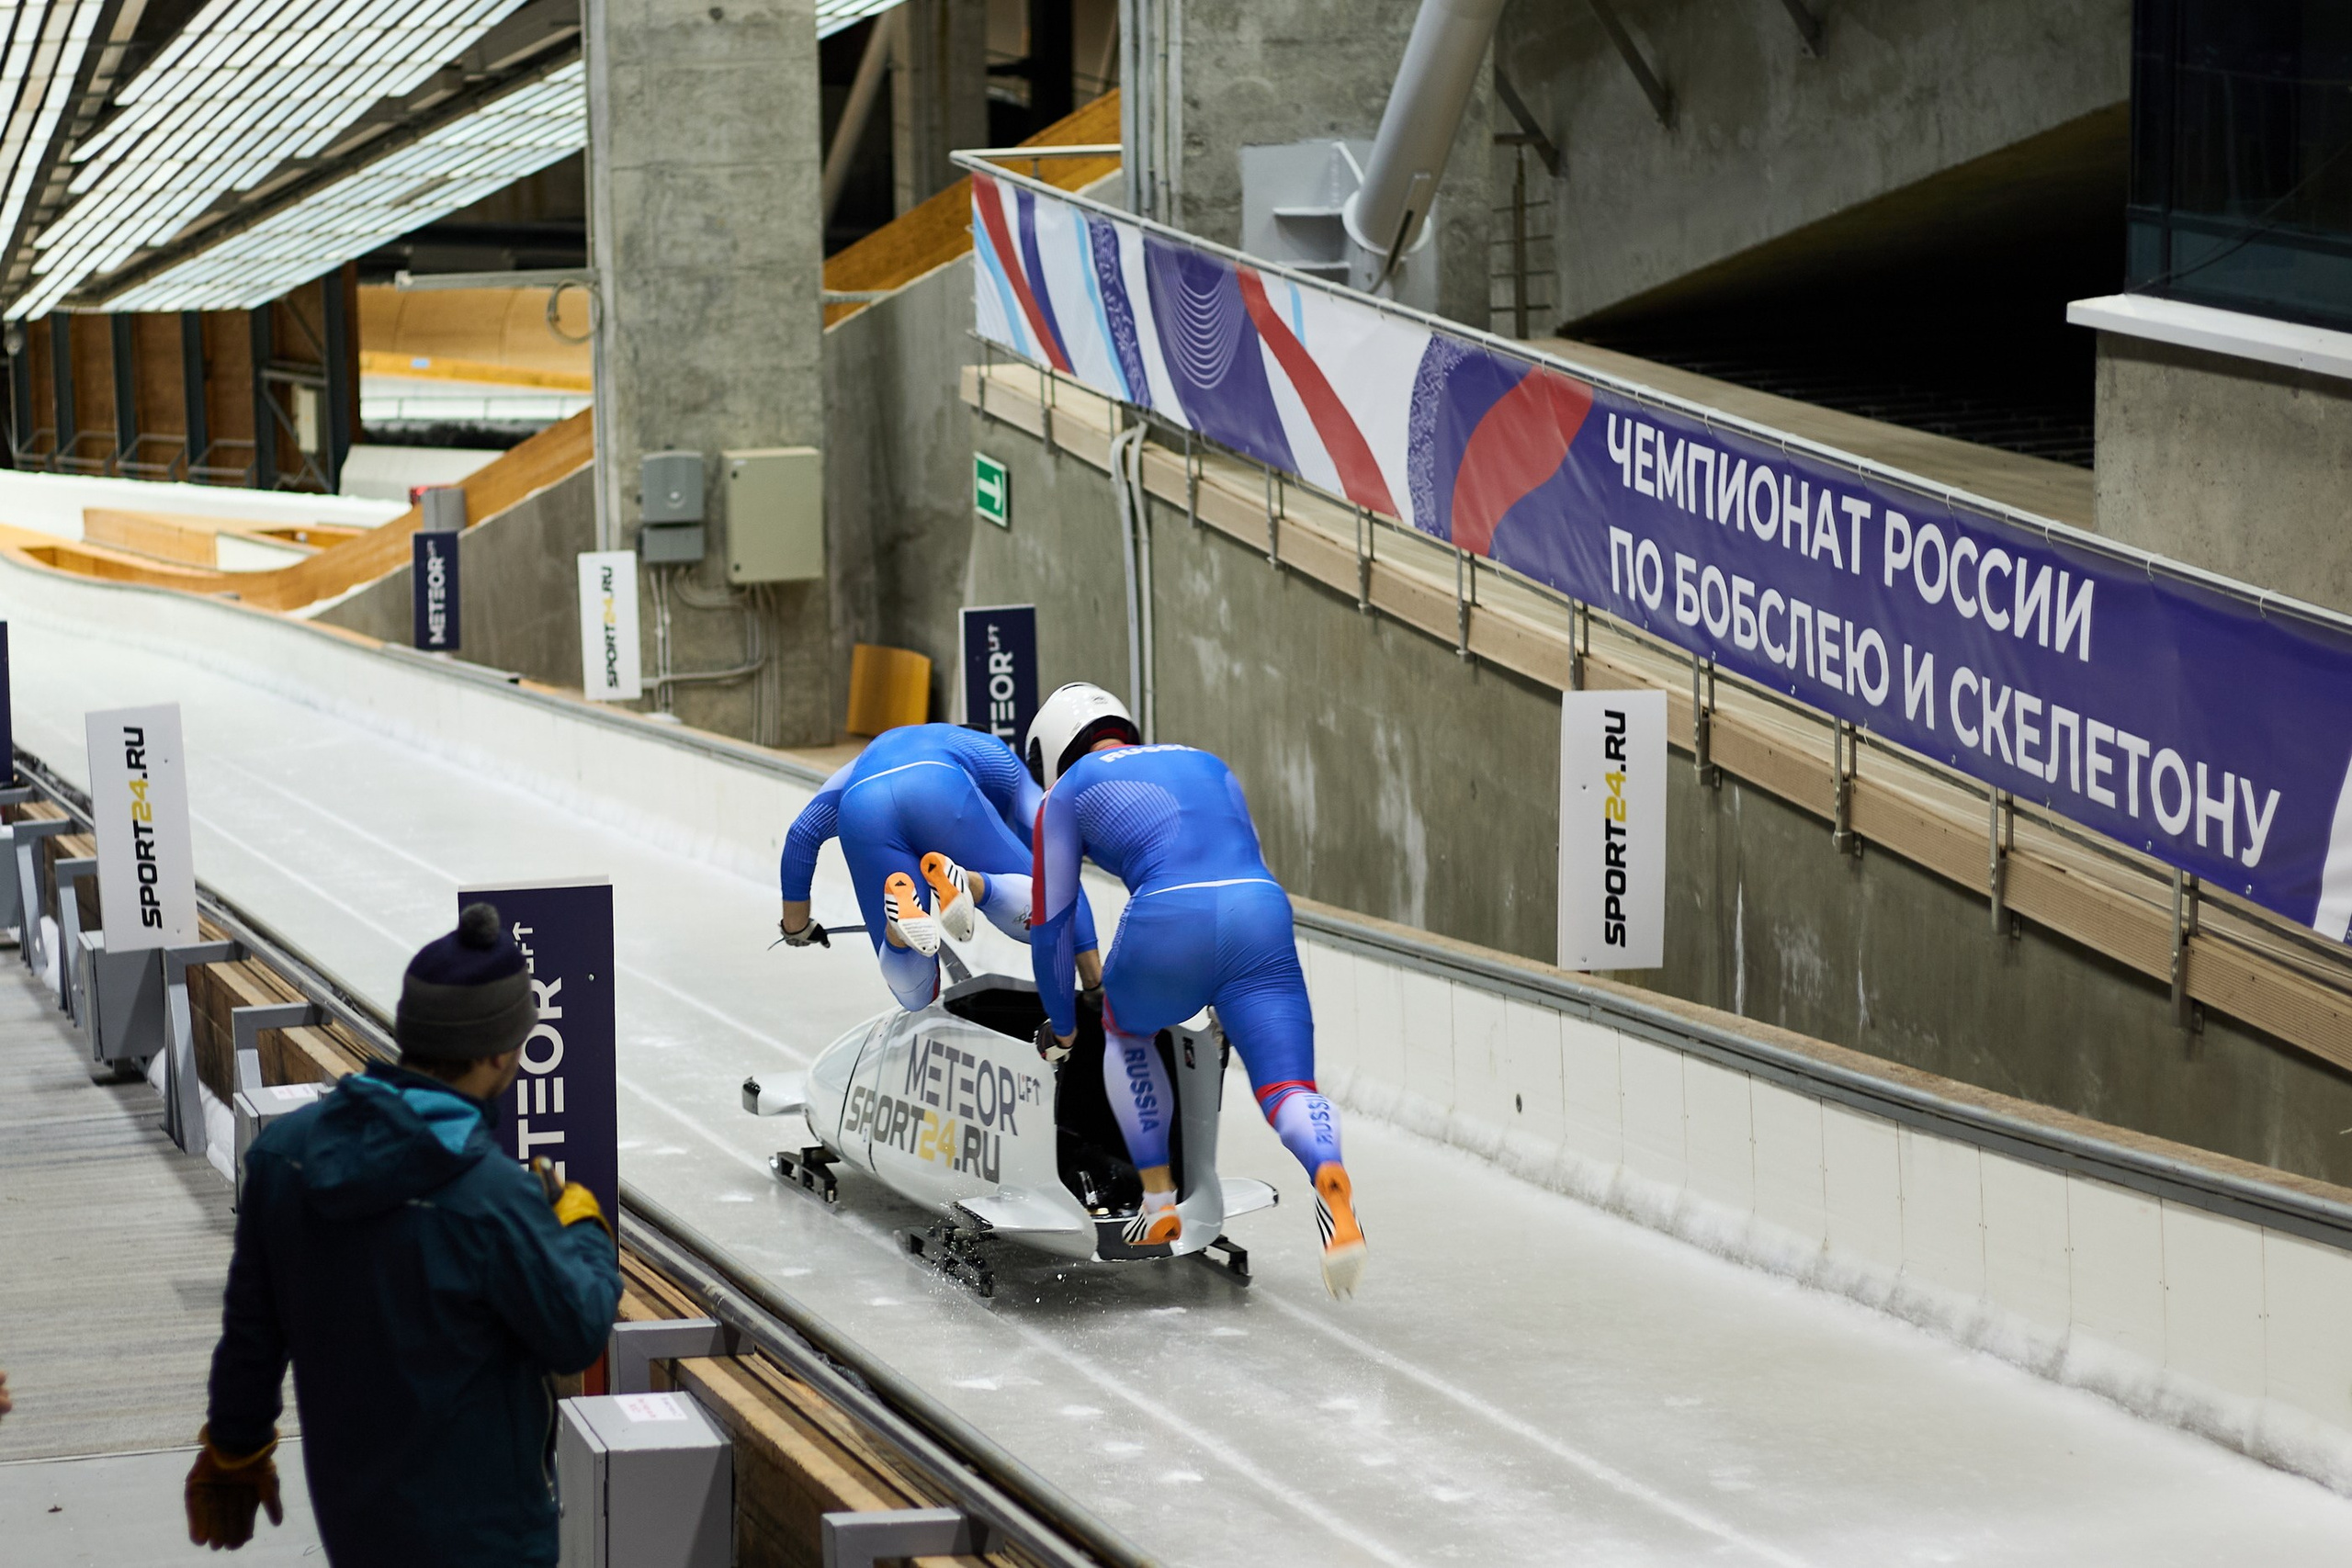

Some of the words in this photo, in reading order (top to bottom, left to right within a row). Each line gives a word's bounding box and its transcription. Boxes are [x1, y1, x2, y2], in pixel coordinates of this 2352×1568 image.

[1608, 413, 1871, 575] ЧЕМПИОНАТ
[1883, 509, 2095, 661] РОССИИ
[602, 566, 619, 688] SPORT24.RU
[1610, 526, 1664, 611] ПО
[1675, 551, 1890, 706] БОБСЛЕЮ
[1904, 643, 1935, 730] И
[1950, 666, 2281, 868] СКЕЛЕТОНУ
[123, 726, 164, 930] SPORT24.RU
[1605, 709, 1626, 948] SPORT24.RU
[844, 1085, 1001, 1185] SPORT24.RU
[904, 1033, 1019, 1136] METEOR
[1124, 1048, 1159, 1134] RUSSIA
[1303, 1094, 1334, 1146] RUSSI
